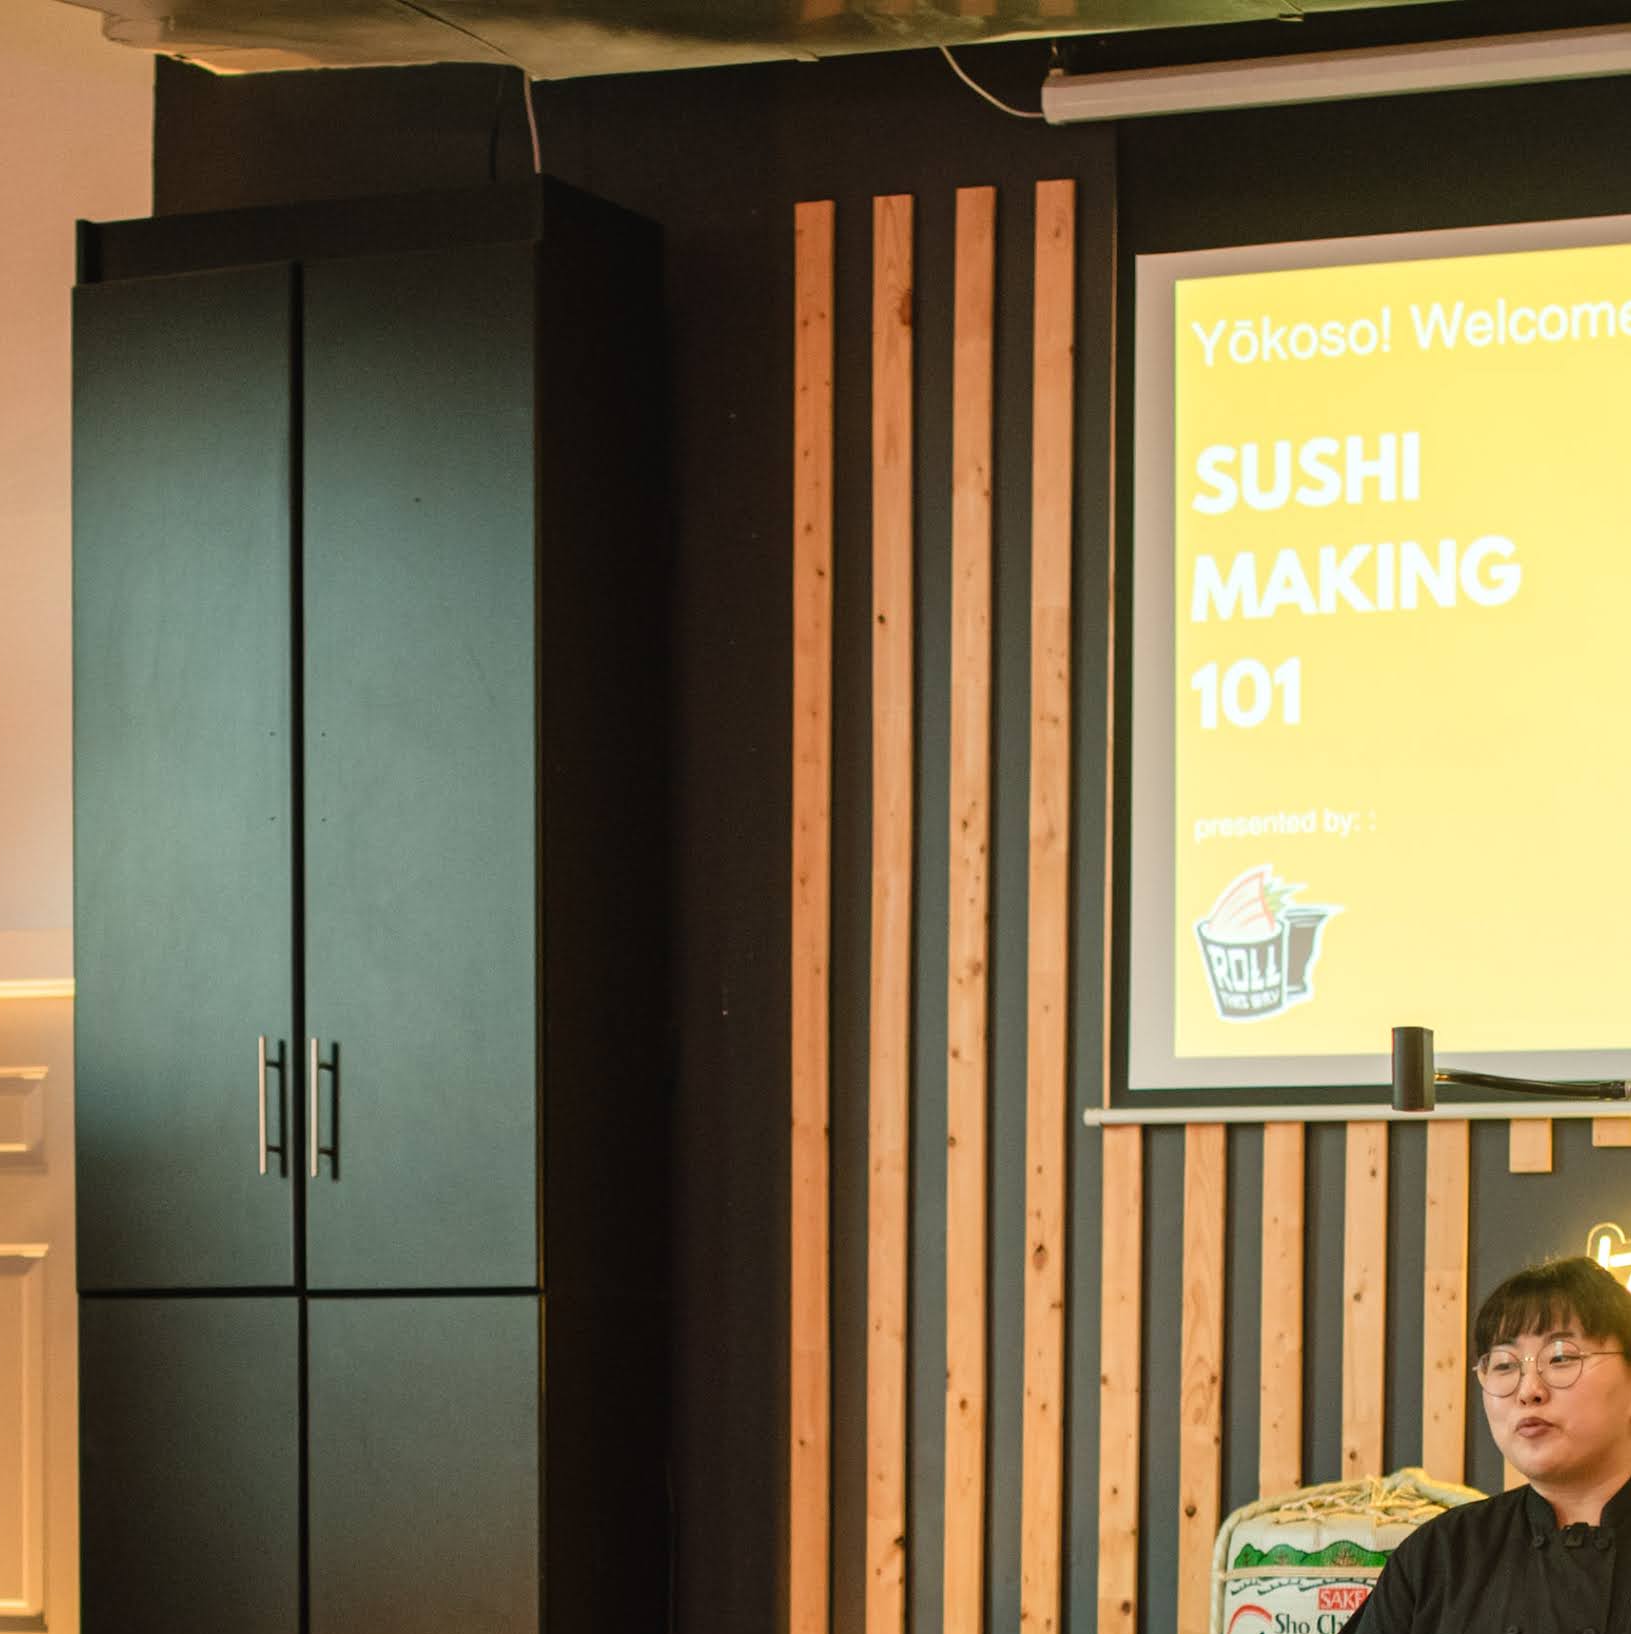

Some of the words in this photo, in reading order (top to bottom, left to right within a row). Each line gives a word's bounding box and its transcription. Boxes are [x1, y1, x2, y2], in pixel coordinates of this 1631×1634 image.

[1191, 307, 1391, 367] Yōkoso!
[1191, 431, 1421, 515] SUSHI
[1190, 535, 1522, 623] MAKING
[1191, 656, 1301, 729] 101
[1194, 809, 1317, 844] presented
[1206, 943, 1282, 992] ROLL
